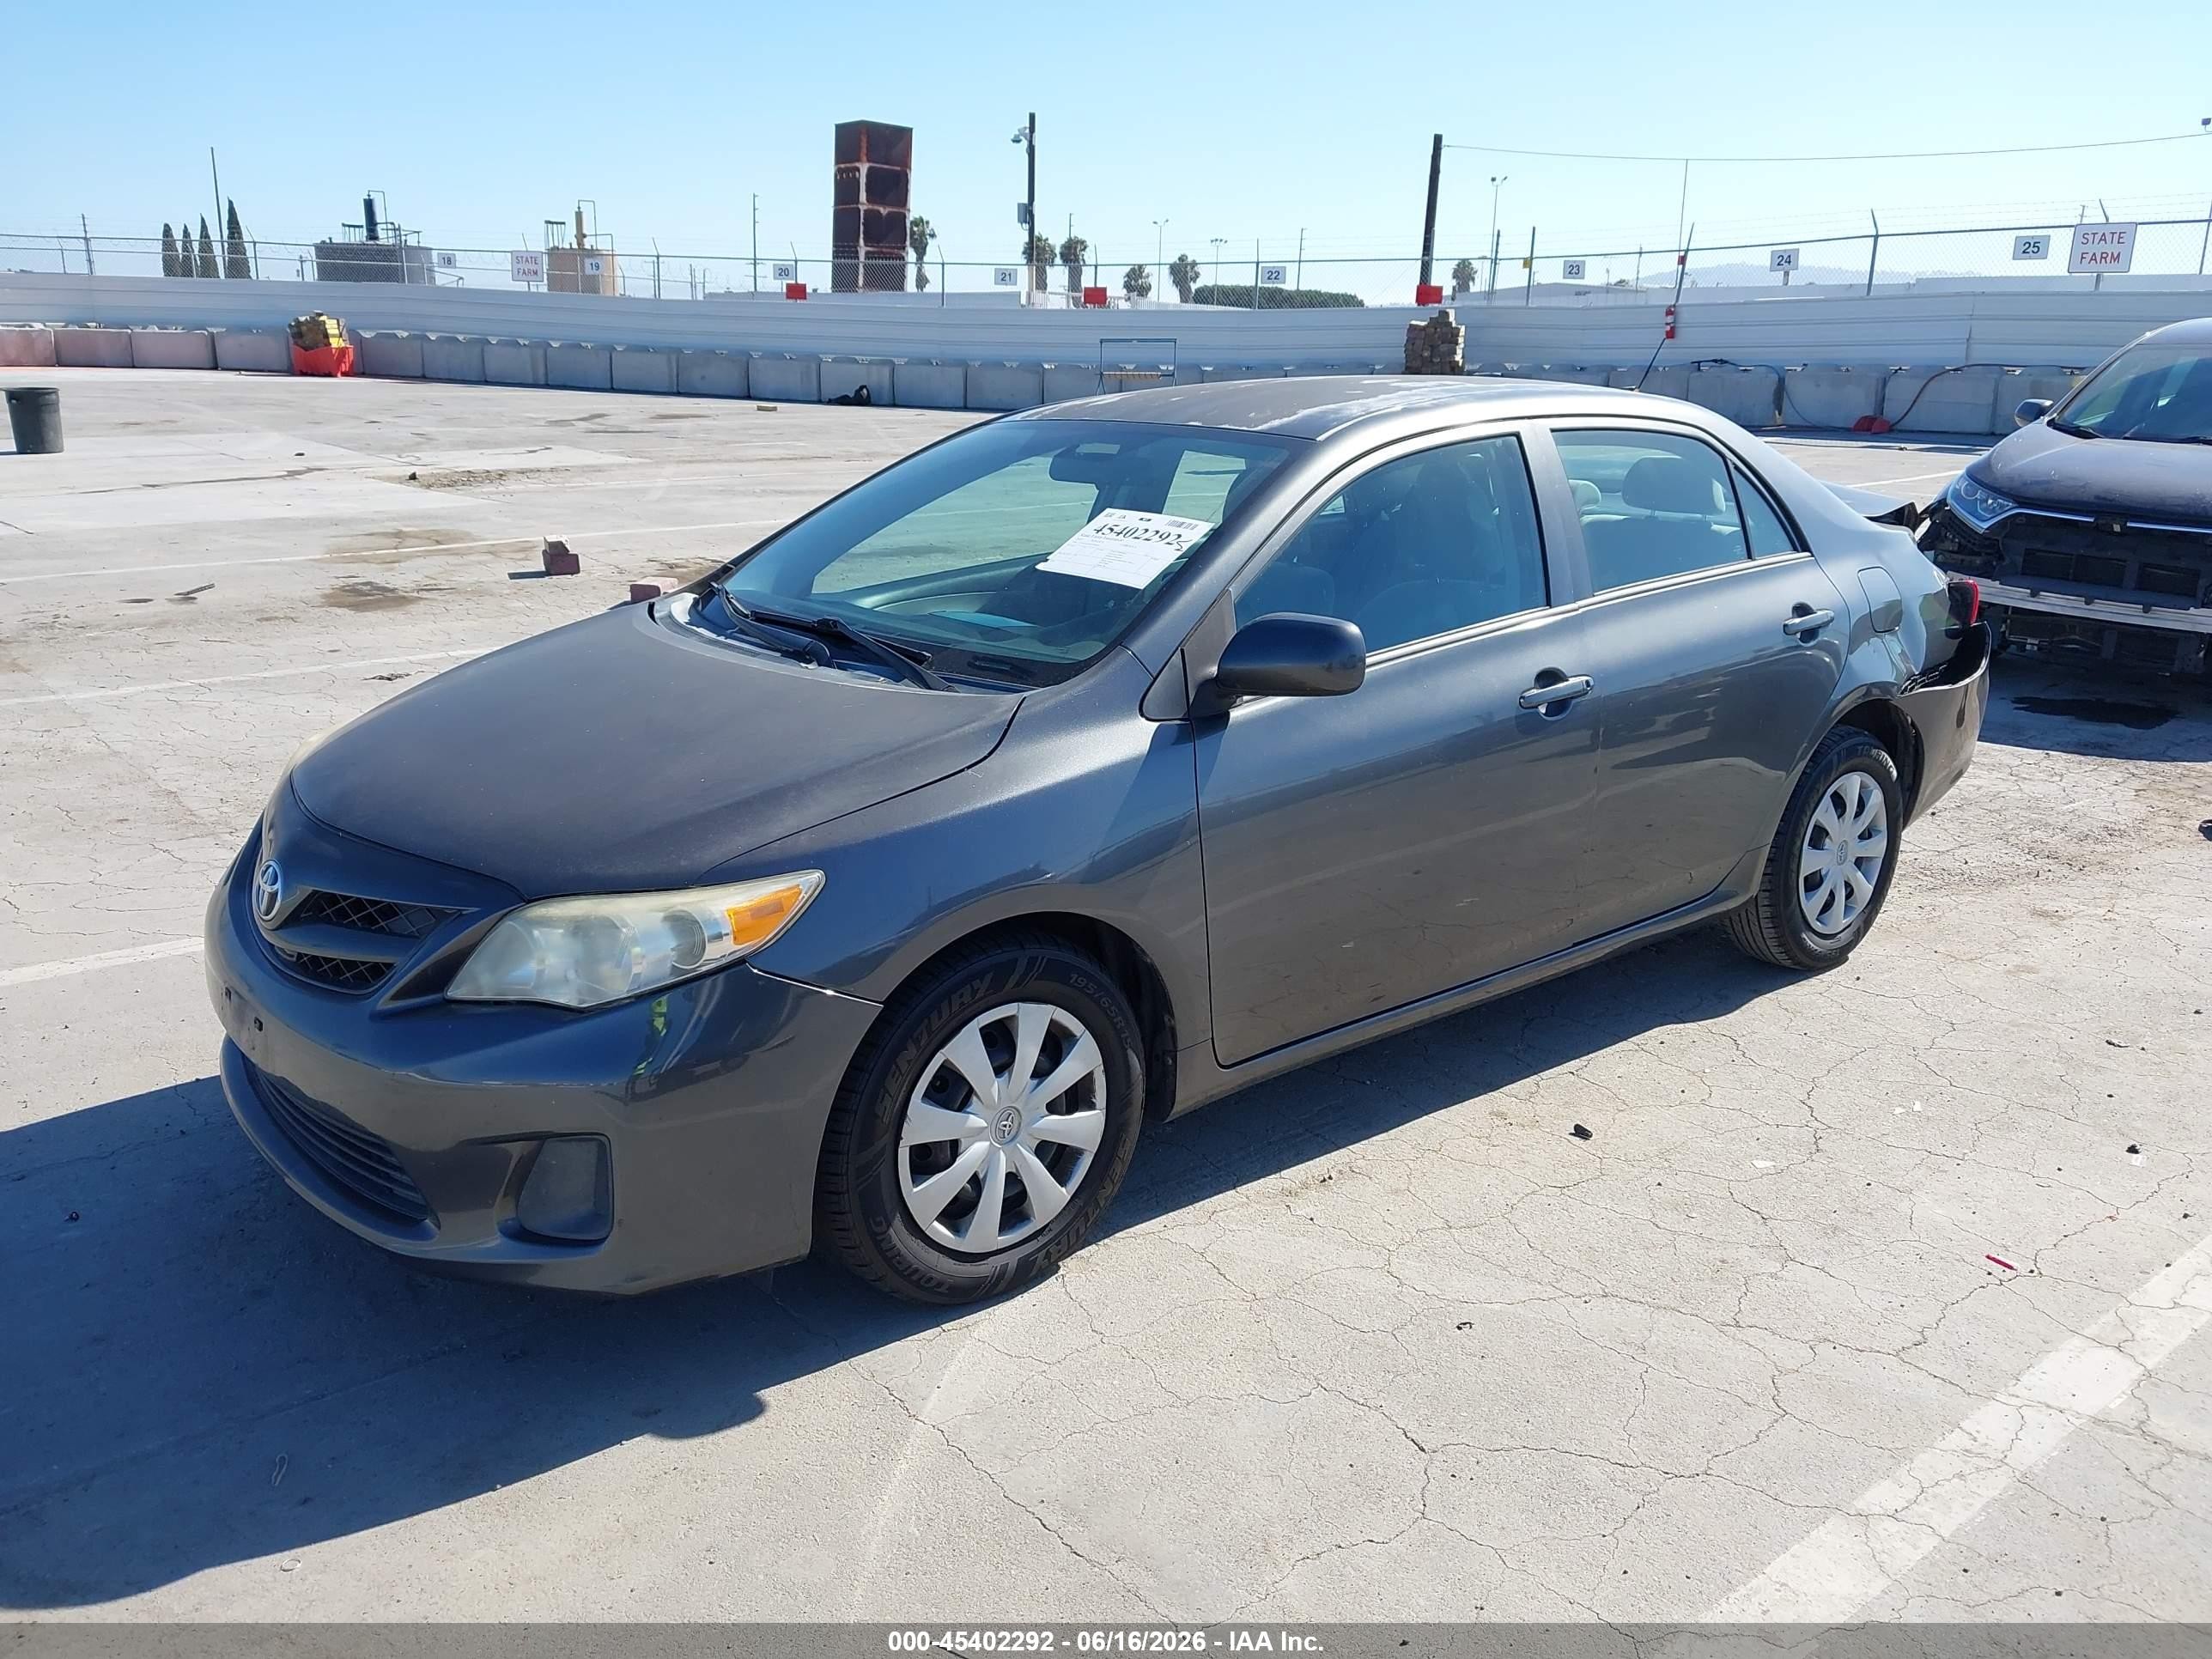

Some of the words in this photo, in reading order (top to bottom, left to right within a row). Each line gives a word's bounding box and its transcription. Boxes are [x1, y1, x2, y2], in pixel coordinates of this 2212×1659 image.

[2081, 231, 2126, 245] STATE
[2021, 241, 2041, 254] 25
[441, 257, 452, 265] 18
[515, 256, 538, 265] STATE
[1777, 254, 1791, 266] 24
[2080, 251, 2121, 264] FARM
[517, 267, 538, 276] FARM
[590, 262, 599, 271] 19
[778, 267, 789, 276] 20
[1568, 264, 1580, 275] 23
[1000, 272, 1012, 282] 21
[1267, 270, 1280, 281] 22
[1093, 523, 1182, 546] 45402292
[1069, 973, 1133, 1049] 195/65R15
[869, 1216, 951, 1294] TOURING
